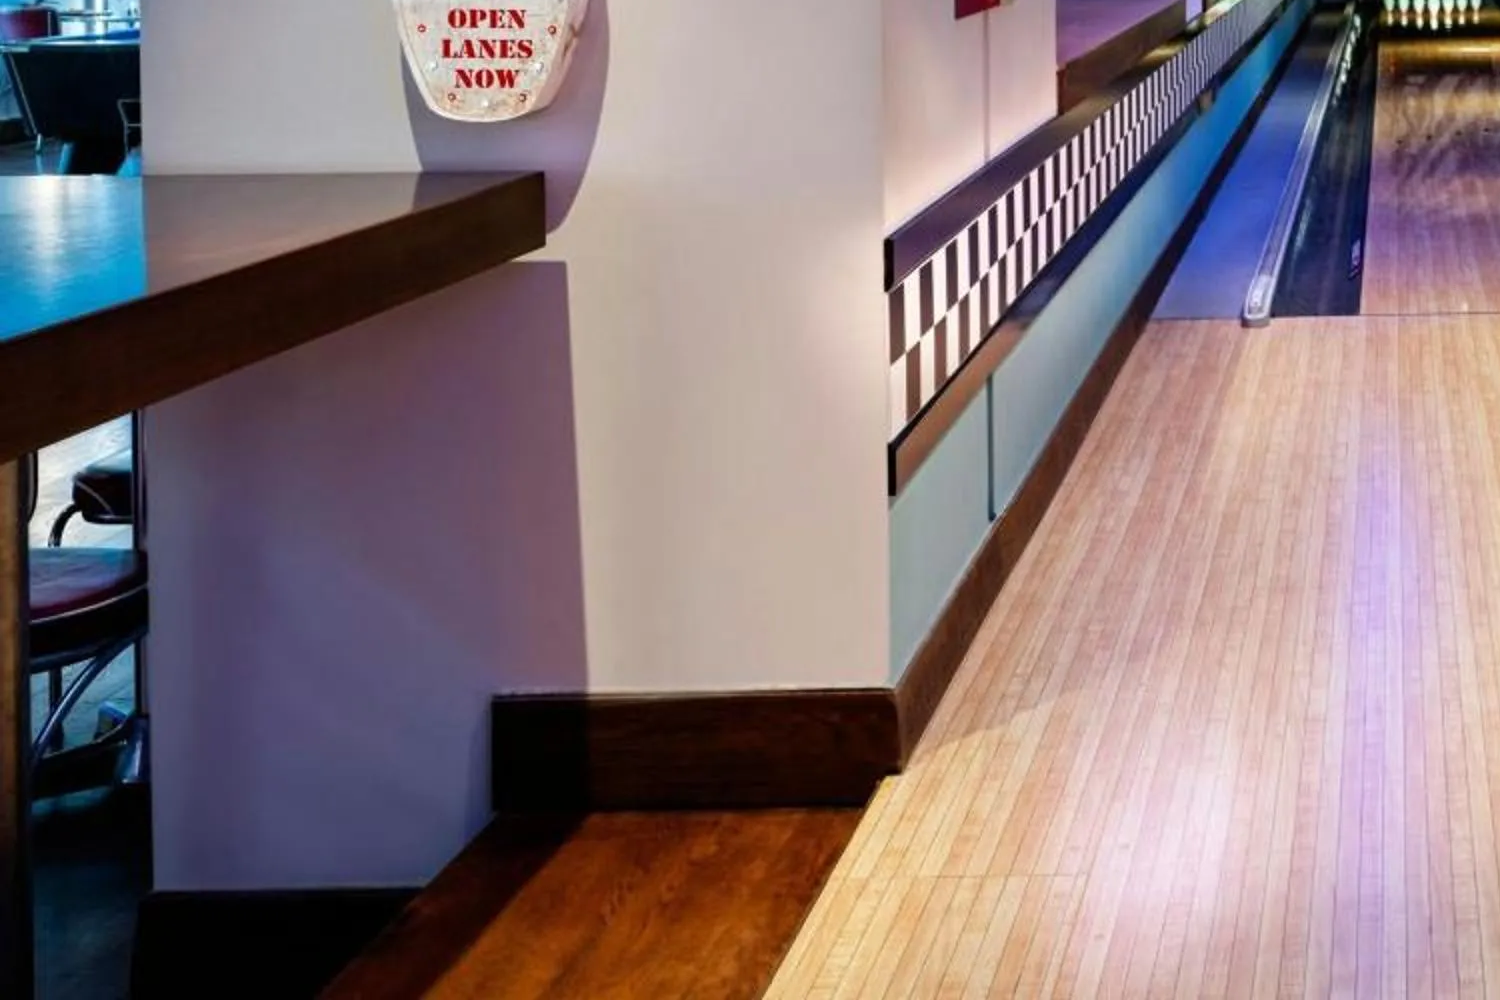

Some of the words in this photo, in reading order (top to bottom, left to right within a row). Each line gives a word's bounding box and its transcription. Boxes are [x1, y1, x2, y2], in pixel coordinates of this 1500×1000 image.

[447, 8, 527, 30] OPEN
[441, 39, 534, 59] LANES
[454, 68, 521, 90] NOW
